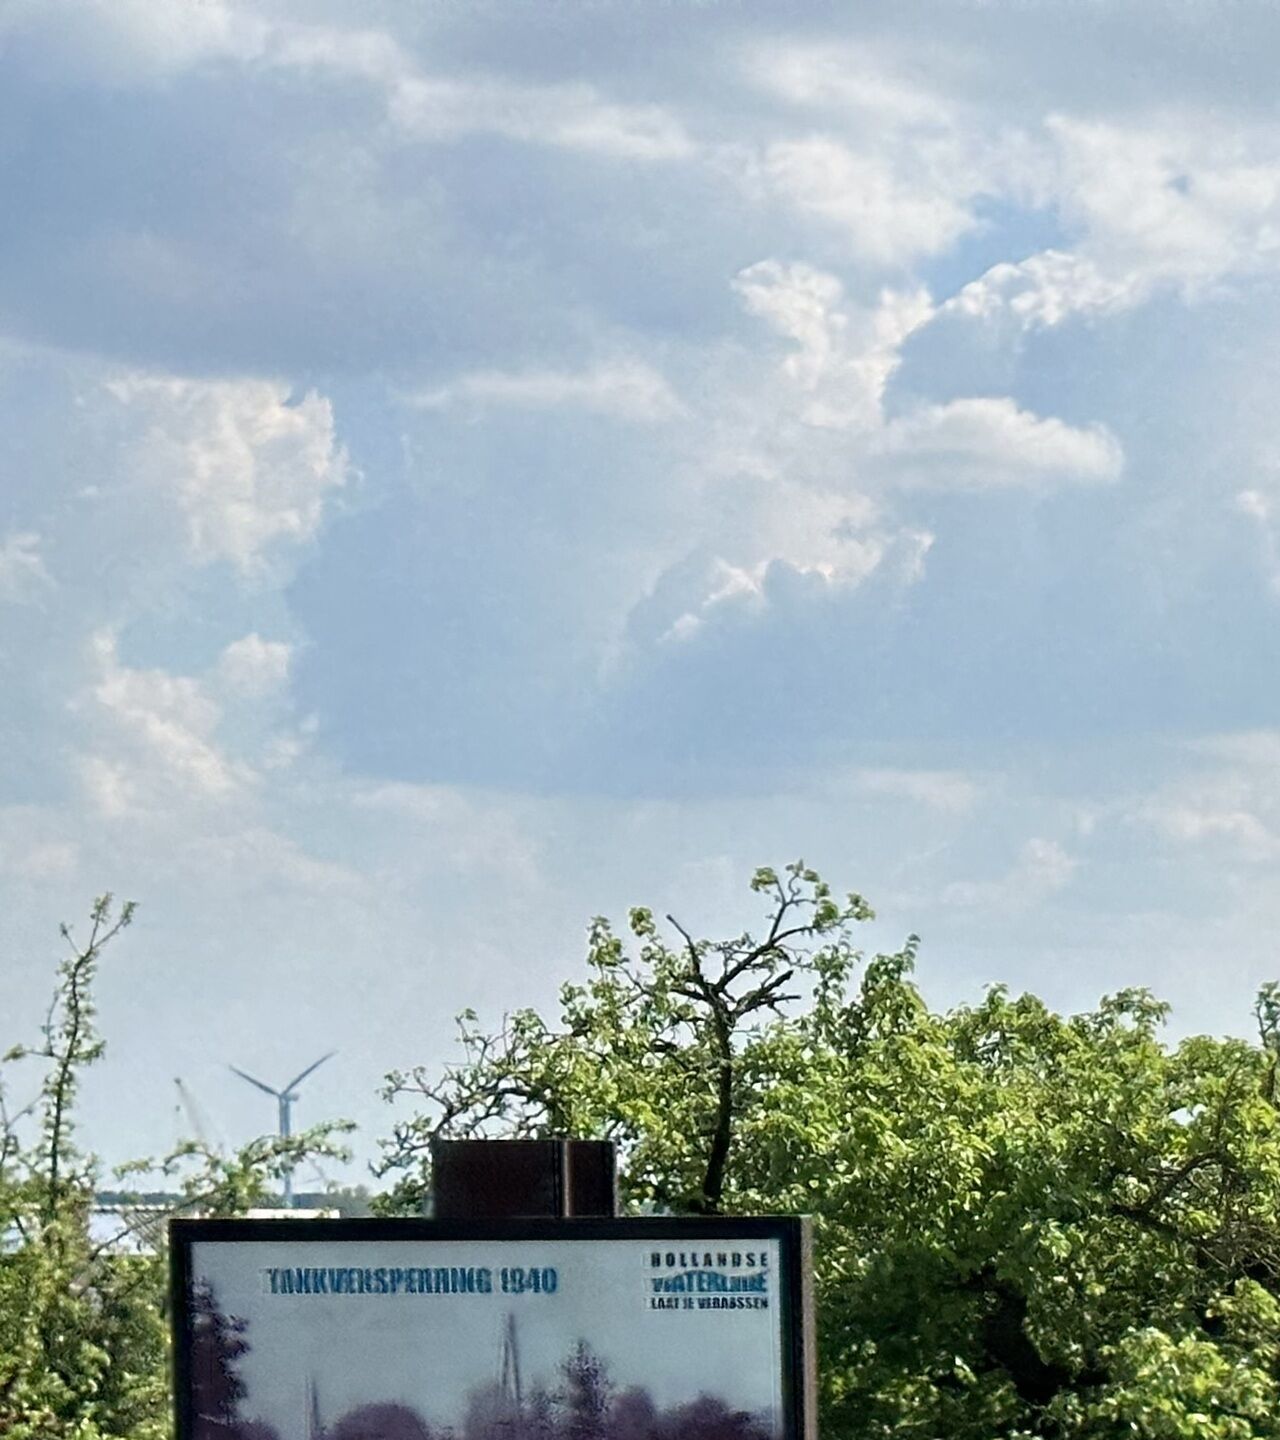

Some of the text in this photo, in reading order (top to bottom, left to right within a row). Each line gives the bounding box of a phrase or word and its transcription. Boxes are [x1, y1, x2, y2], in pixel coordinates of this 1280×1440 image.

[651, 1252, 768, 1267] HOLLANDSE
[265, 1268, 557, 1294] TANKVERSPERRING 1940
